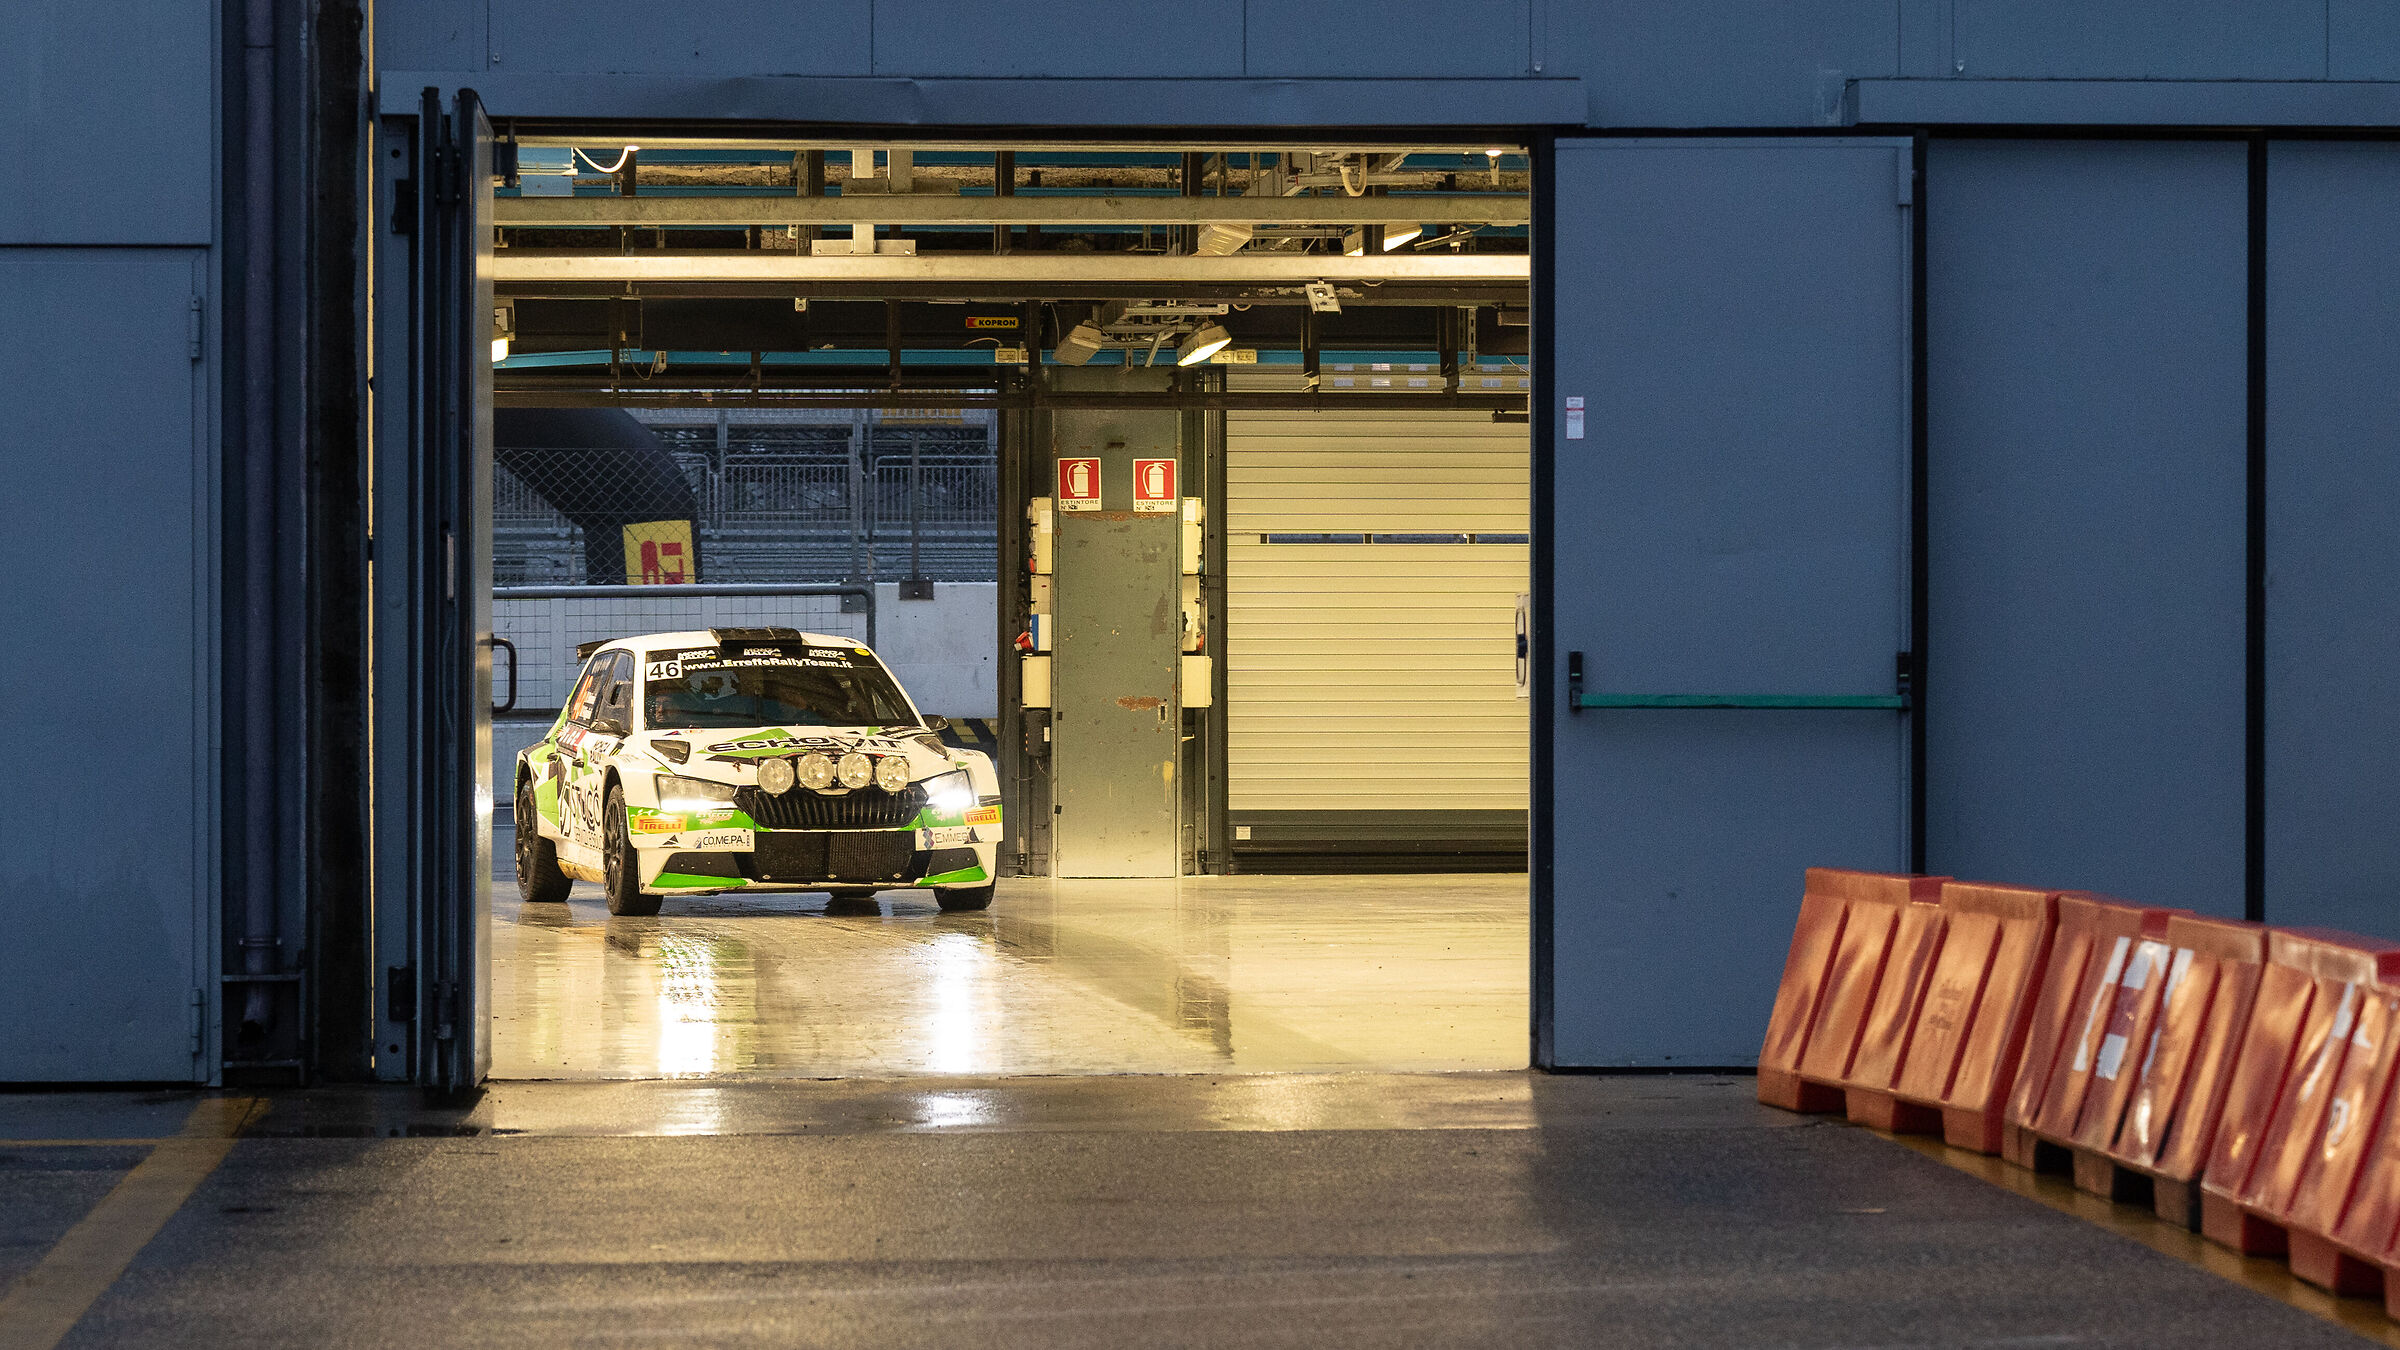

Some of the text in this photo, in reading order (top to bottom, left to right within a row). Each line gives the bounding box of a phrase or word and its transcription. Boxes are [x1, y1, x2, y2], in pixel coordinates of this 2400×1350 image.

[649, 662, 680, 678] 46
[682, 657, 854, 671] www.ErreffeRallyTeam.it
[706, 737, 903, 752] ECHOVIT
[964, 808, 997, 823] PIRELLI
[638, 818, 683, 830] PIRELLI
